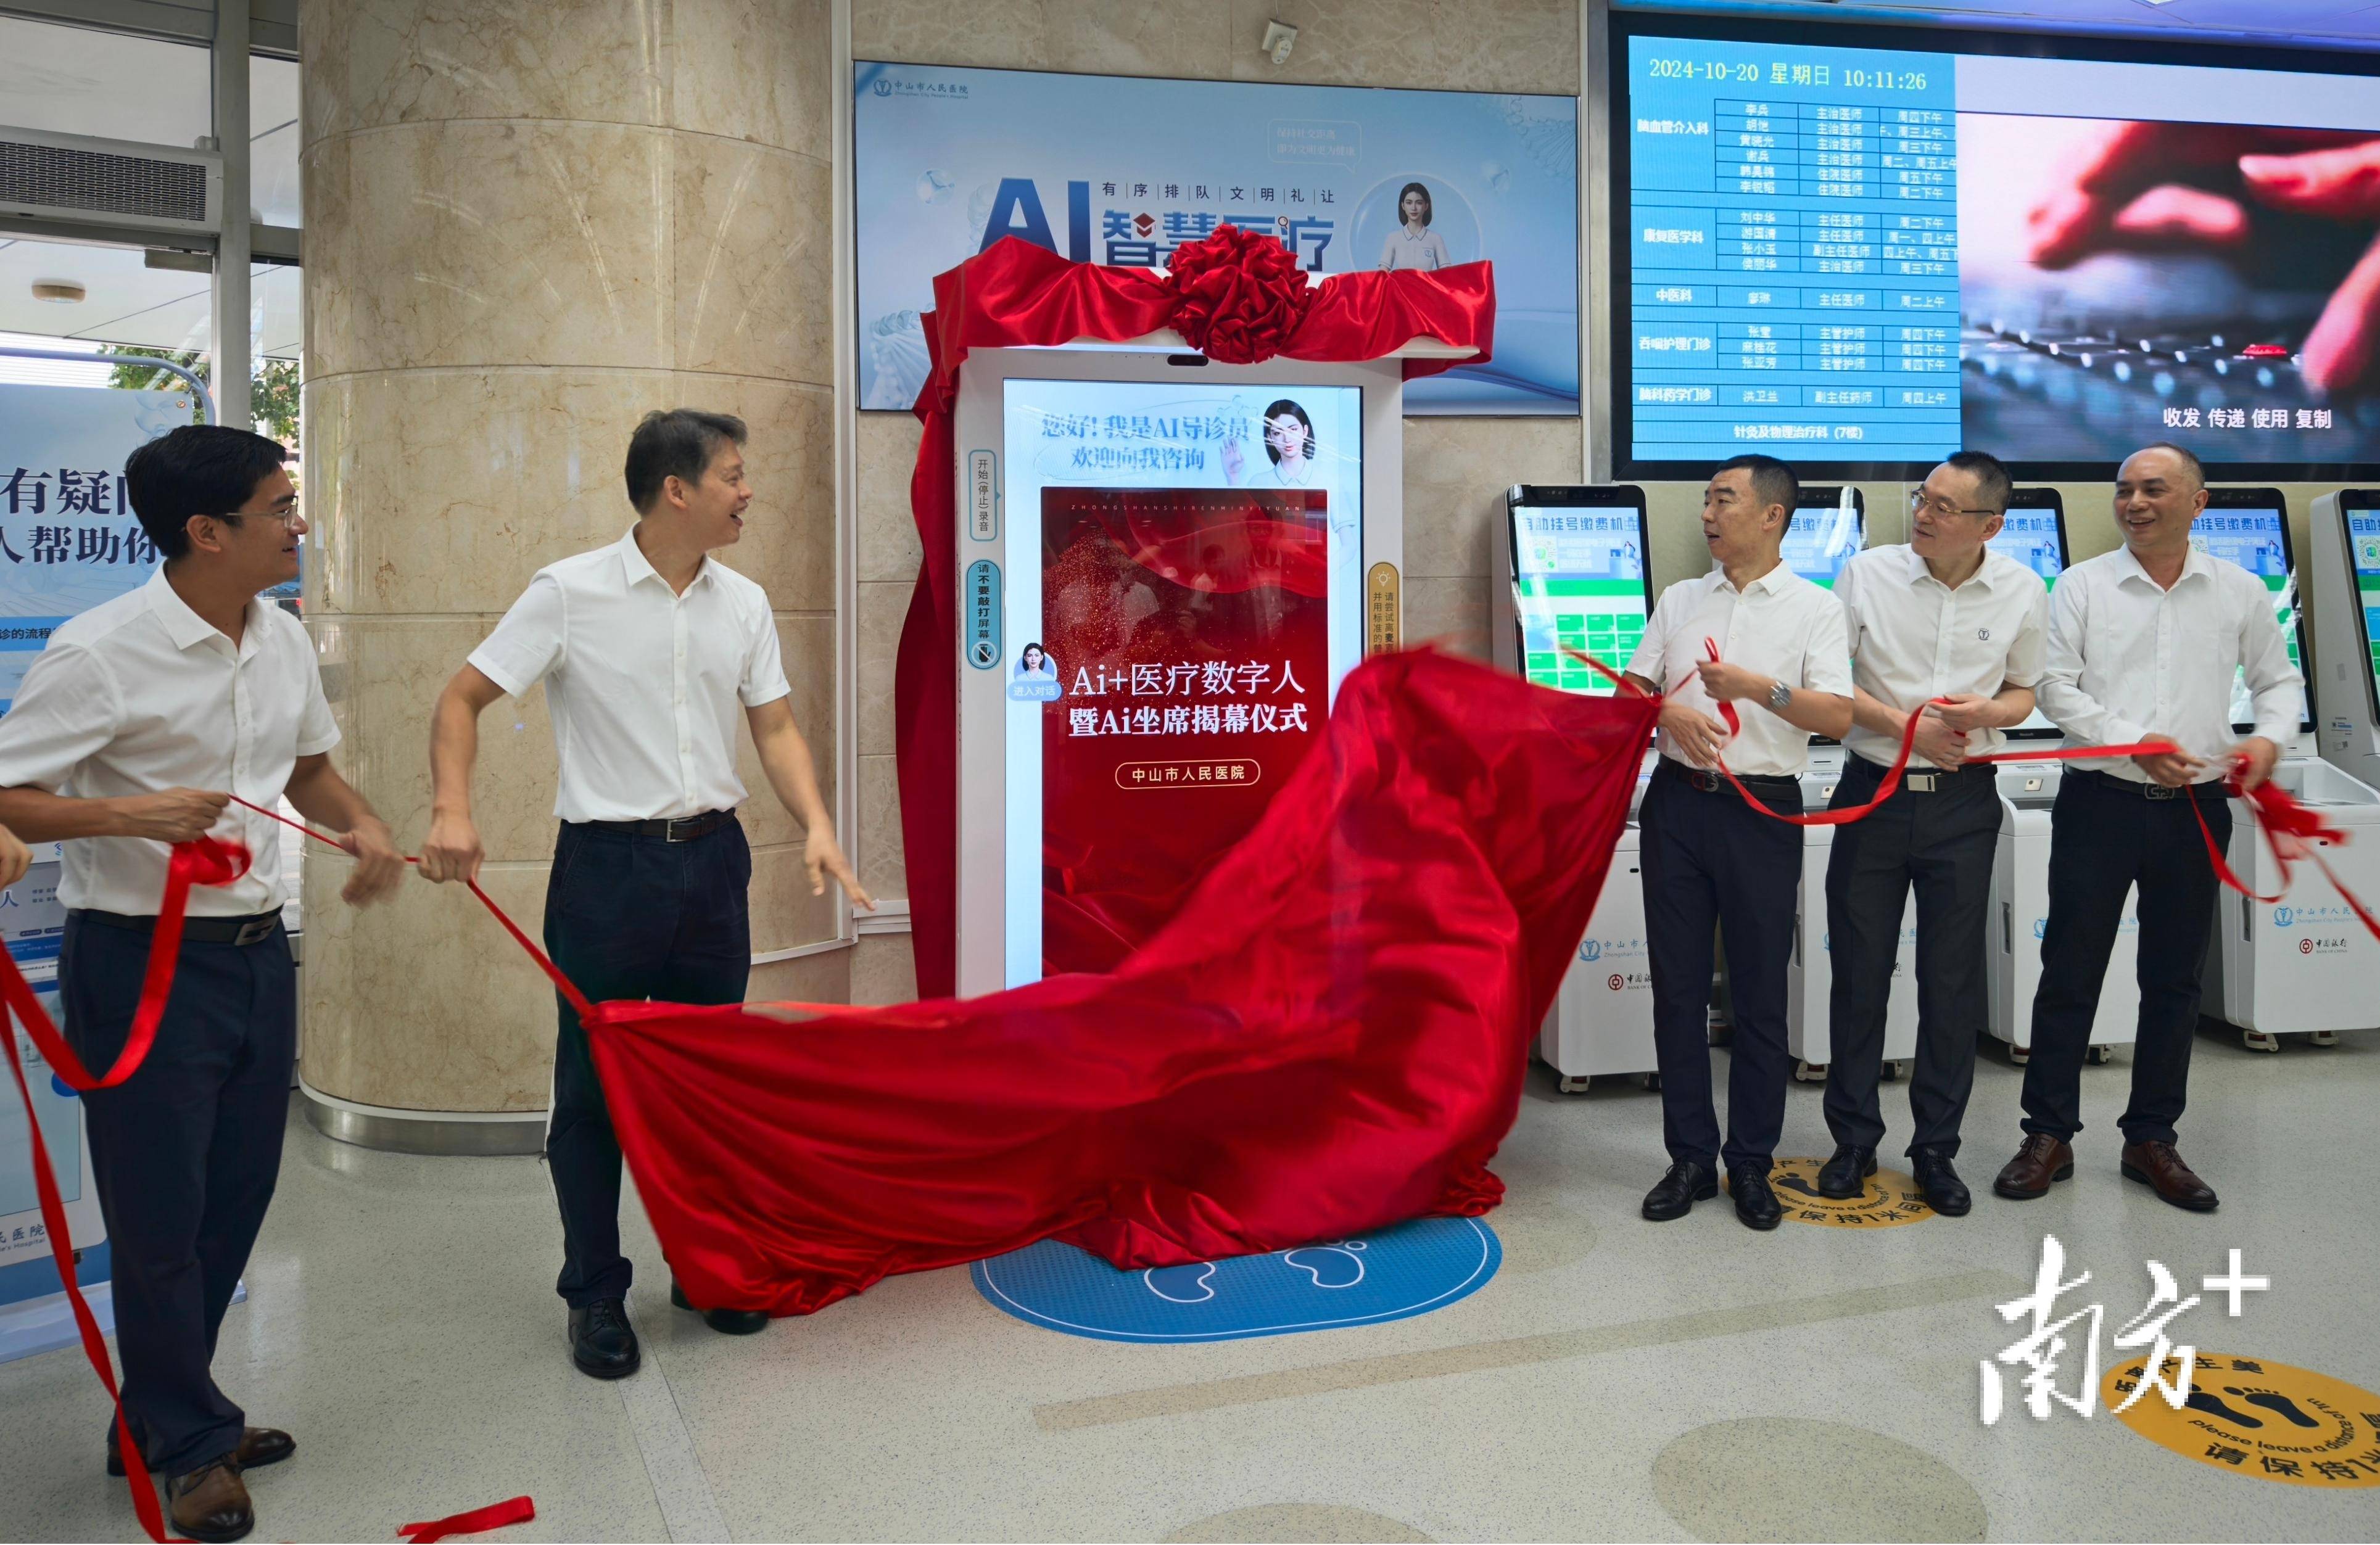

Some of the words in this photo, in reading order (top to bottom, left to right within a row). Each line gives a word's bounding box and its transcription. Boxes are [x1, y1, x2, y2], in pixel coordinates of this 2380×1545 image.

[1650, 59, 1758, 81] 2024-10-20
[1771, 64, 1828, 84] 星期日
[1845, 70, 1926, 89] 10:11:26
[895, 81, 969, 94] 中山市人民医院
[1817, 108, 1861, 120] 主治医师
[1817, 123, 1861, 135] 主治医师
[1818, 139, 1862, 150] 主治医师
[1818, 154, 1862, 166] 主治医师
[1818, 169, 1862, 181] 住院医师
[1818, 184, 1862, 196] 住院医师
[978, 178, 1091, 263] AI
[1740, 213, 1775, 223] 刘中华
[1819, 215, 1862, 226] 主任医师
[1643, 229, 1703, 243] 康复医学科
[1819, 231, 1863, 242] 主任医师
[1812, 245, 1869, 257] 副主任医师
[1819, 261, 1863, 273] 主治医师
[1655, 289, 1692, 302] 中医科
[1820, 294, 1864, 306] 主任医师
[1820, 328, 1864, 339] 主管护师
[1820, 343, 1864, 355] 主管护师
[1820, 358, 1864, 370] 主管护师
[1814, 392, 1871, 403] 副主任药师
[2163, 408, 2200, 427] 收发
[2207, 409, 2244, 427] 传递
[2250, 409, 2287, 428] 使用
[2295, 410, 2331, 428] 复制
[1733, 426, 1828, 439] 针灸及物理治疗科
[1071, 448, 1205, 471] 欢迎向我咨询
[0, 467, 127, 516] 有疑
[2352, 519, 2380, 530] 自助
[978, 564, 990, 639] 请不要敲打屏幕
[0, 628, 56, 640] 诊的流程
[1068, 661, 1306, 696] Ai+医疗数字人
[1013, 686, 1056, 697] 进入对话
[1068, 702, 1308, 737] 暨Ai坐席揭幕仪式
[1132, 765, 1245, 783] 中山市人民医院
[2296, 907, 2373, 916] 中山市人民院
[2316, 938, 2348, 948] 中国银行
[2188, 1419, 2252, 1446] please
[2258, 1441, 2313, 1453] leave
